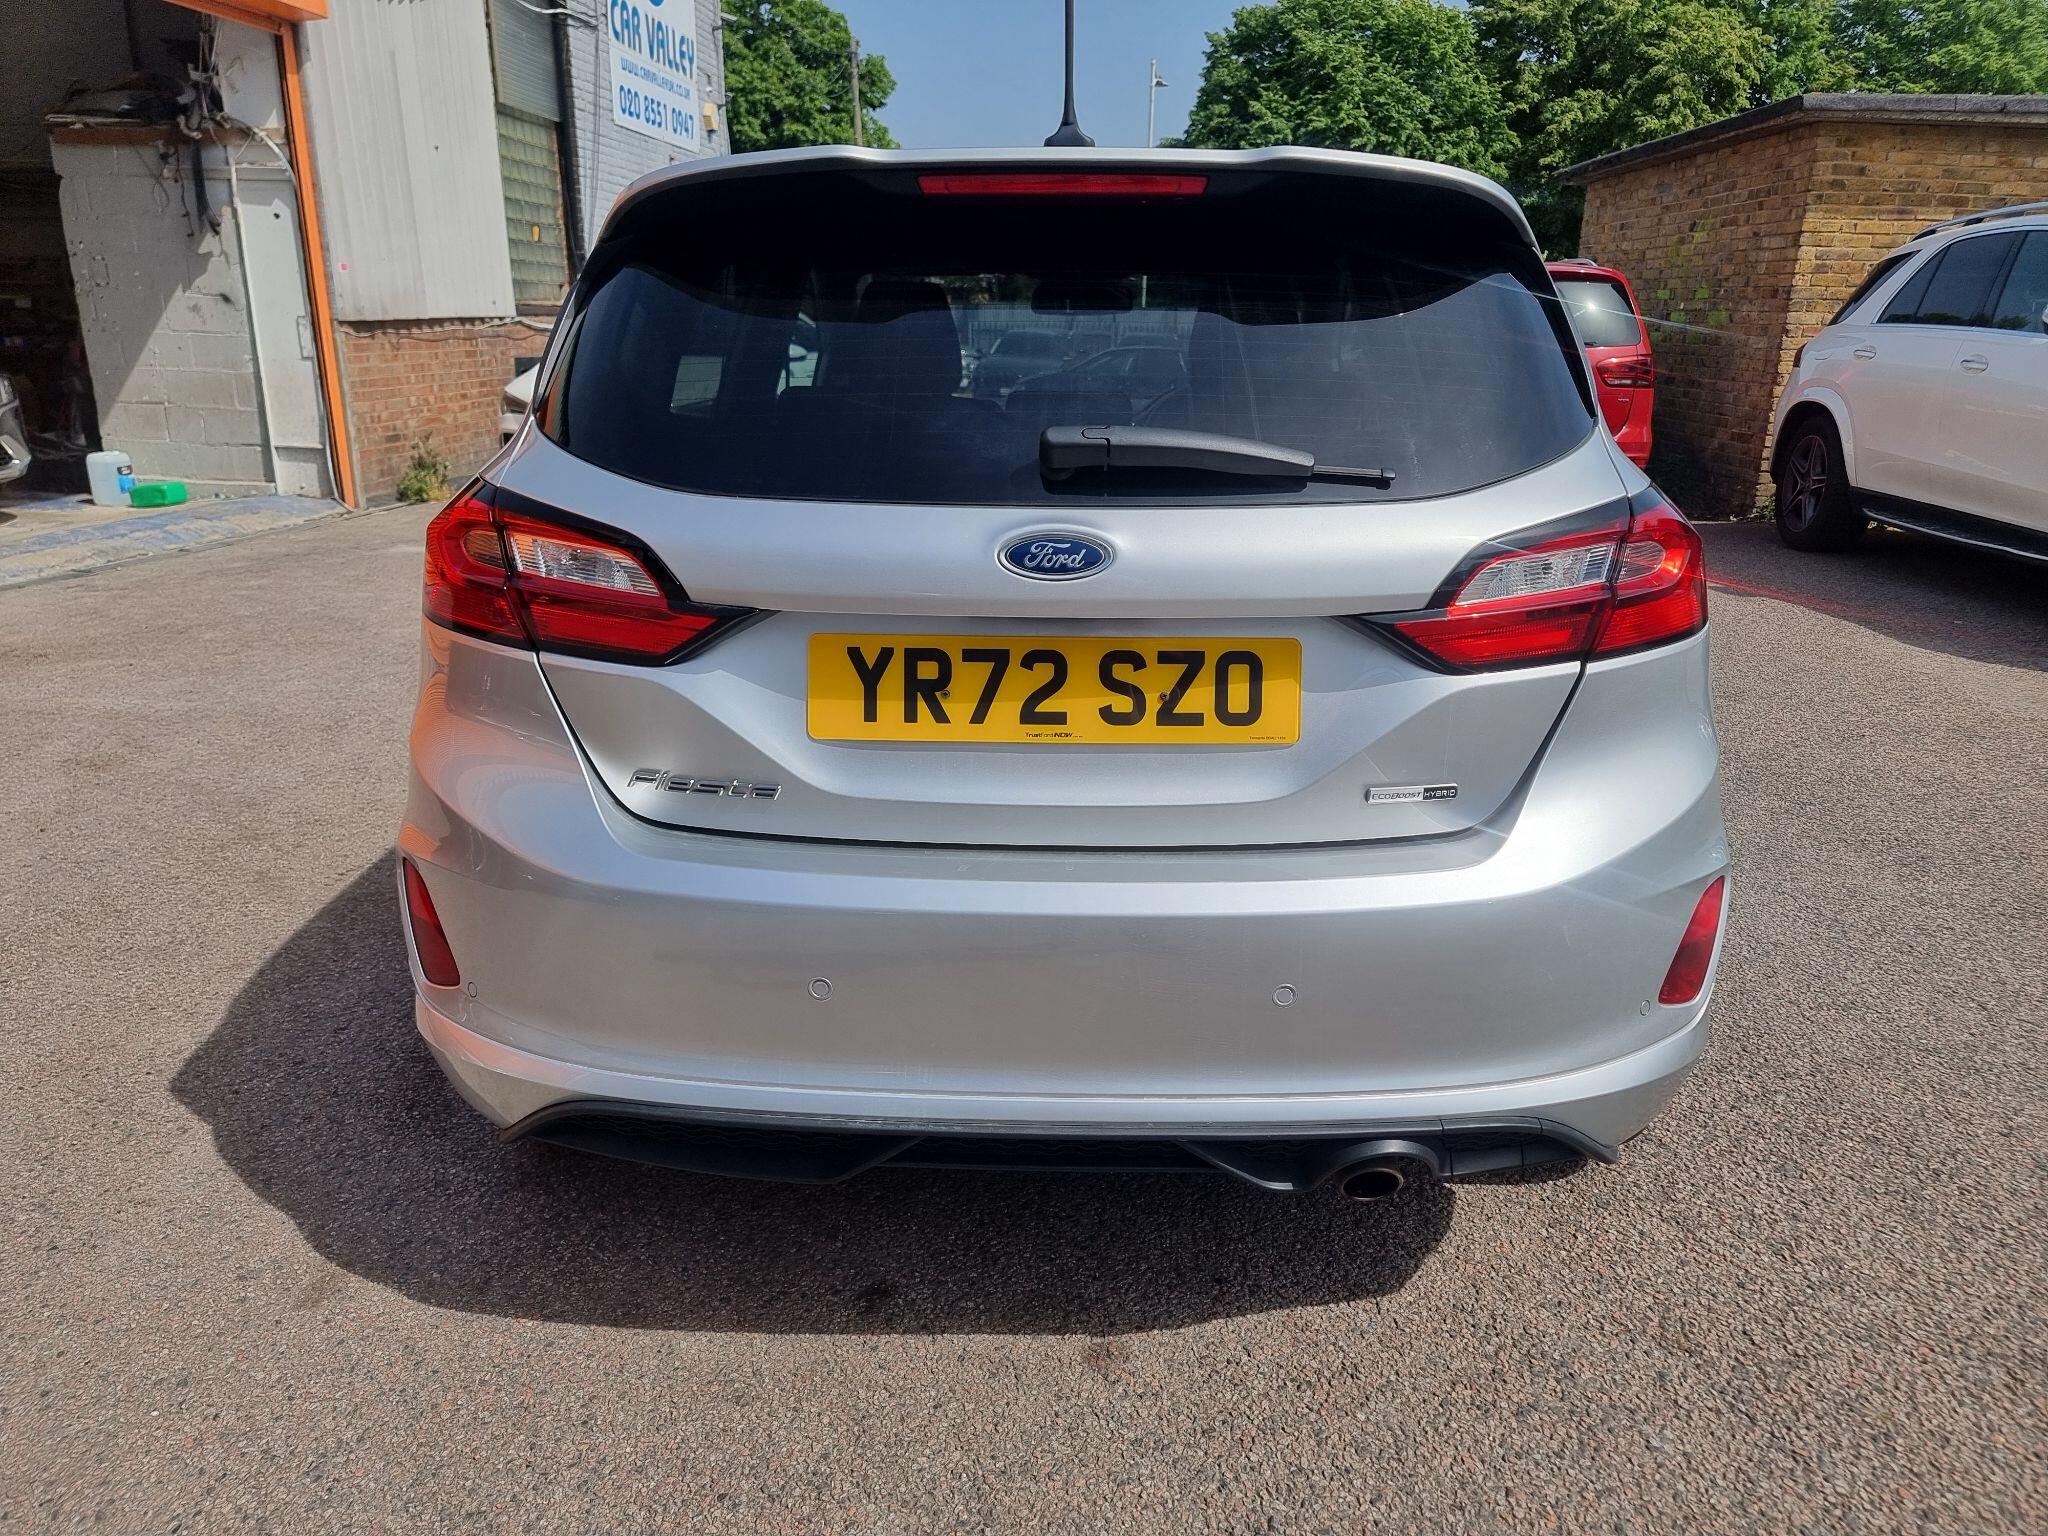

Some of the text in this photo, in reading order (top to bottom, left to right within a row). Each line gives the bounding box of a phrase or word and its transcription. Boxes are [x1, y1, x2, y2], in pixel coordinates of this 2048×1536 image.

[610, 0, 695, 80] CAR VALLEY
[619, 84, 694, 140] 020 8551 0947
[1024, 541, 1087, 569] Ford
[847, 646, 1264, 727] YR72 SZO
[627, 768, 783, 801] Fiesta
[1423, 788, 1456, 798] HYBRID
